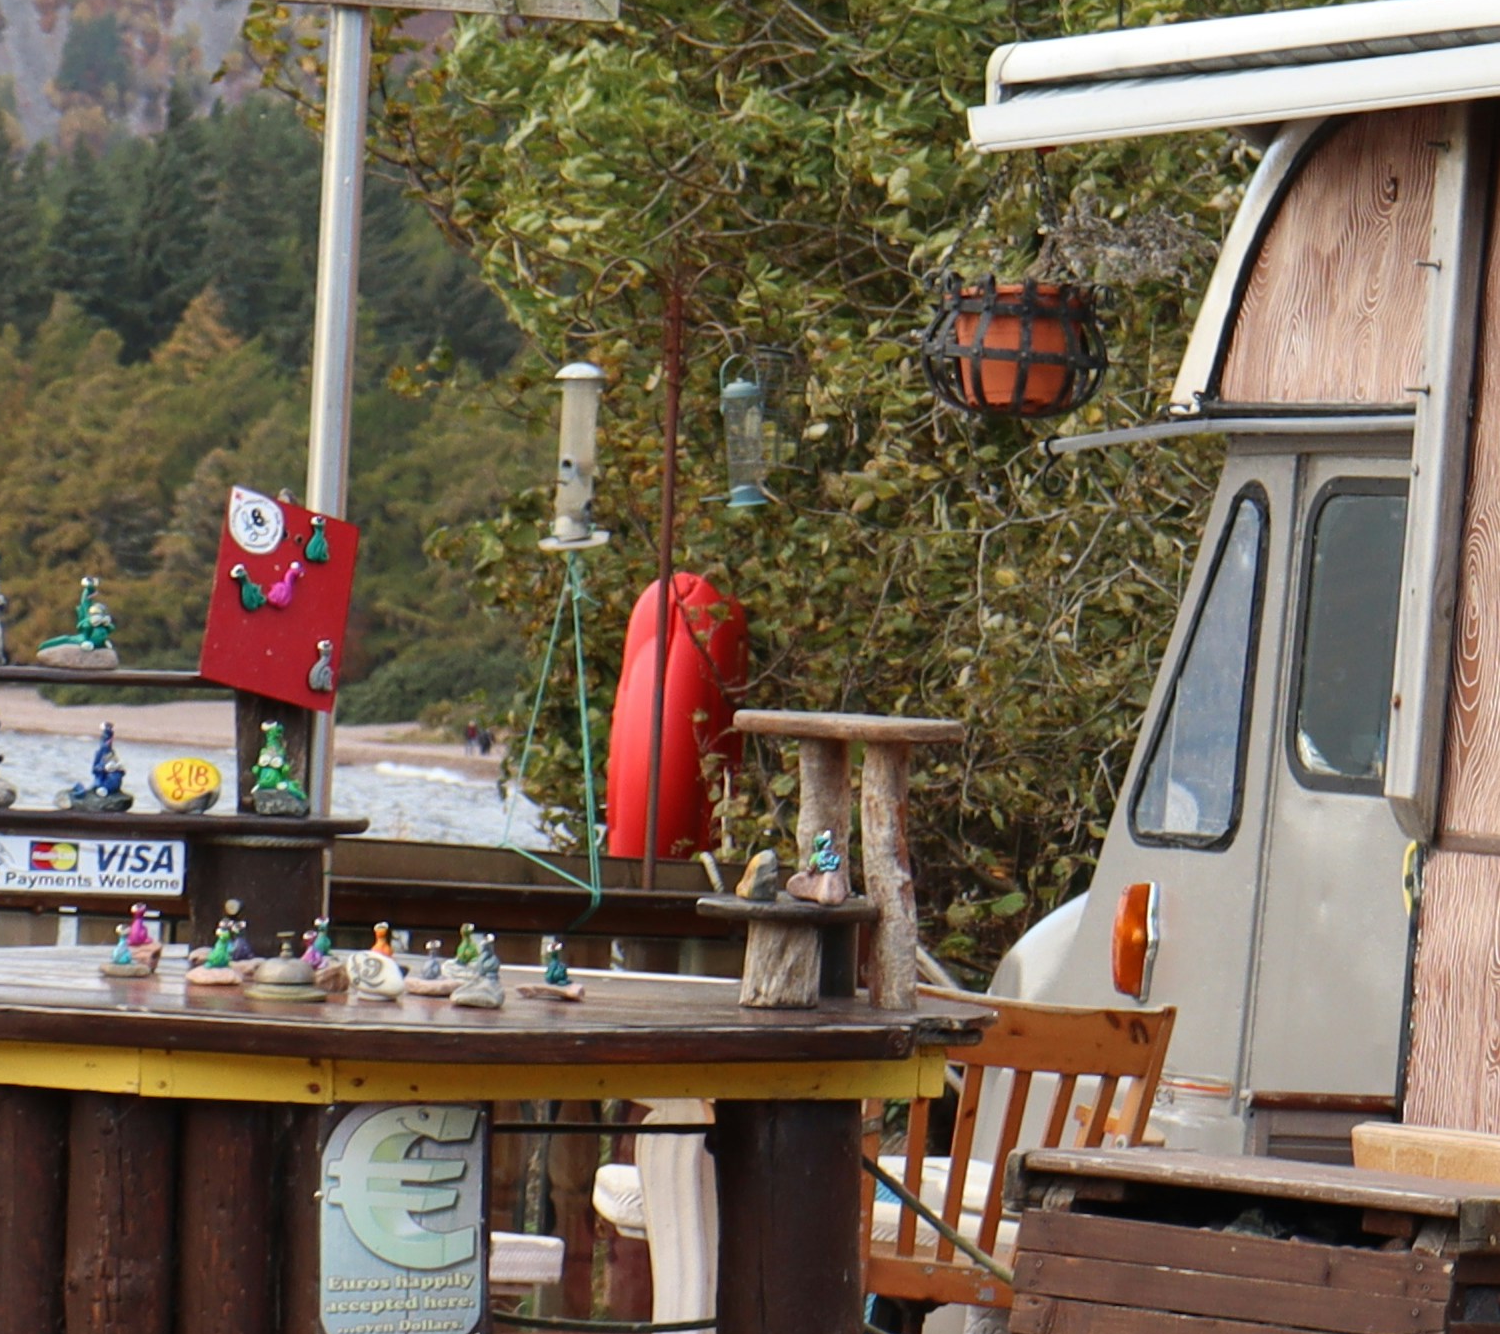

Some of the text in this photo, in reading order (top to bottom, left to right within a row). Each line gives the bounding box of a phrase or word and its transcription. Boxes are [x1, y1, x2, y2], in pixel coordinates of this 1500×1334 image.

[166, 761, 210, 801] £18
[97, 843, 175, 874] VISA
[5, 873, 92, 889] Payments
[99, 875, 180, 891] Welcome
[327, 1272, 474, 1292] Euros happily
[325, 1295, 476, 1315] accepted here.
[399, 1318, 465, 1332] Dollars.
